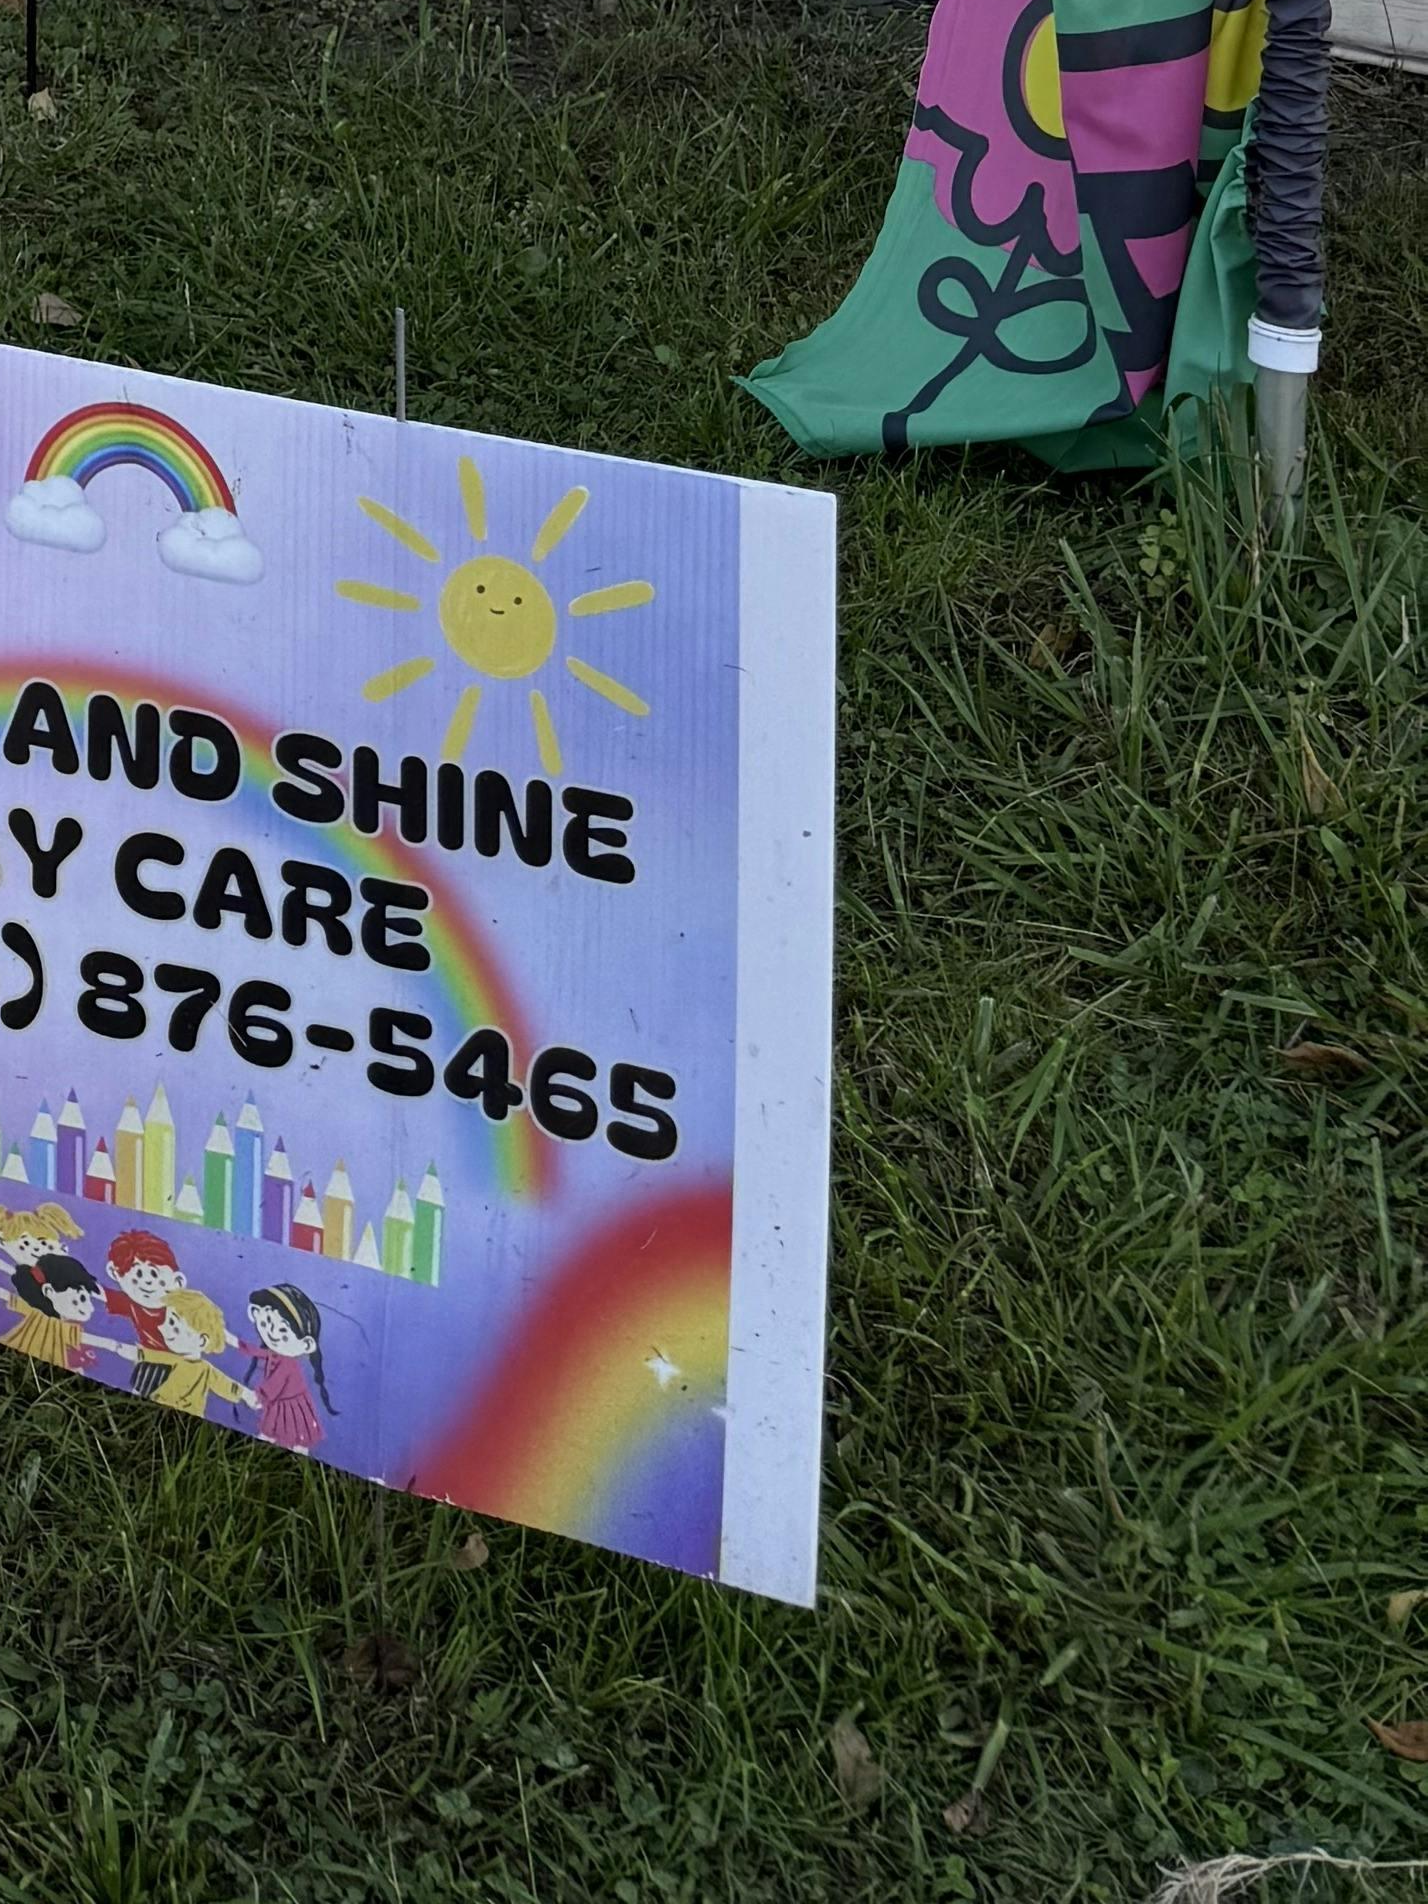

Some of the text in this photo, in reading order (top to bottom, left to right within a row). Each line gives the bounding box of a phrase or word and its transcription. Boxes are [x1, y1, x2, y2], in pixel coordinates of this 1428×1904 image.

[2, 681, 242, 803] AND
[271, 732, 637, 885] SHINE
[113, 831, 432, 973] CARE
[76, 950, 679, 1162] 876-5465
